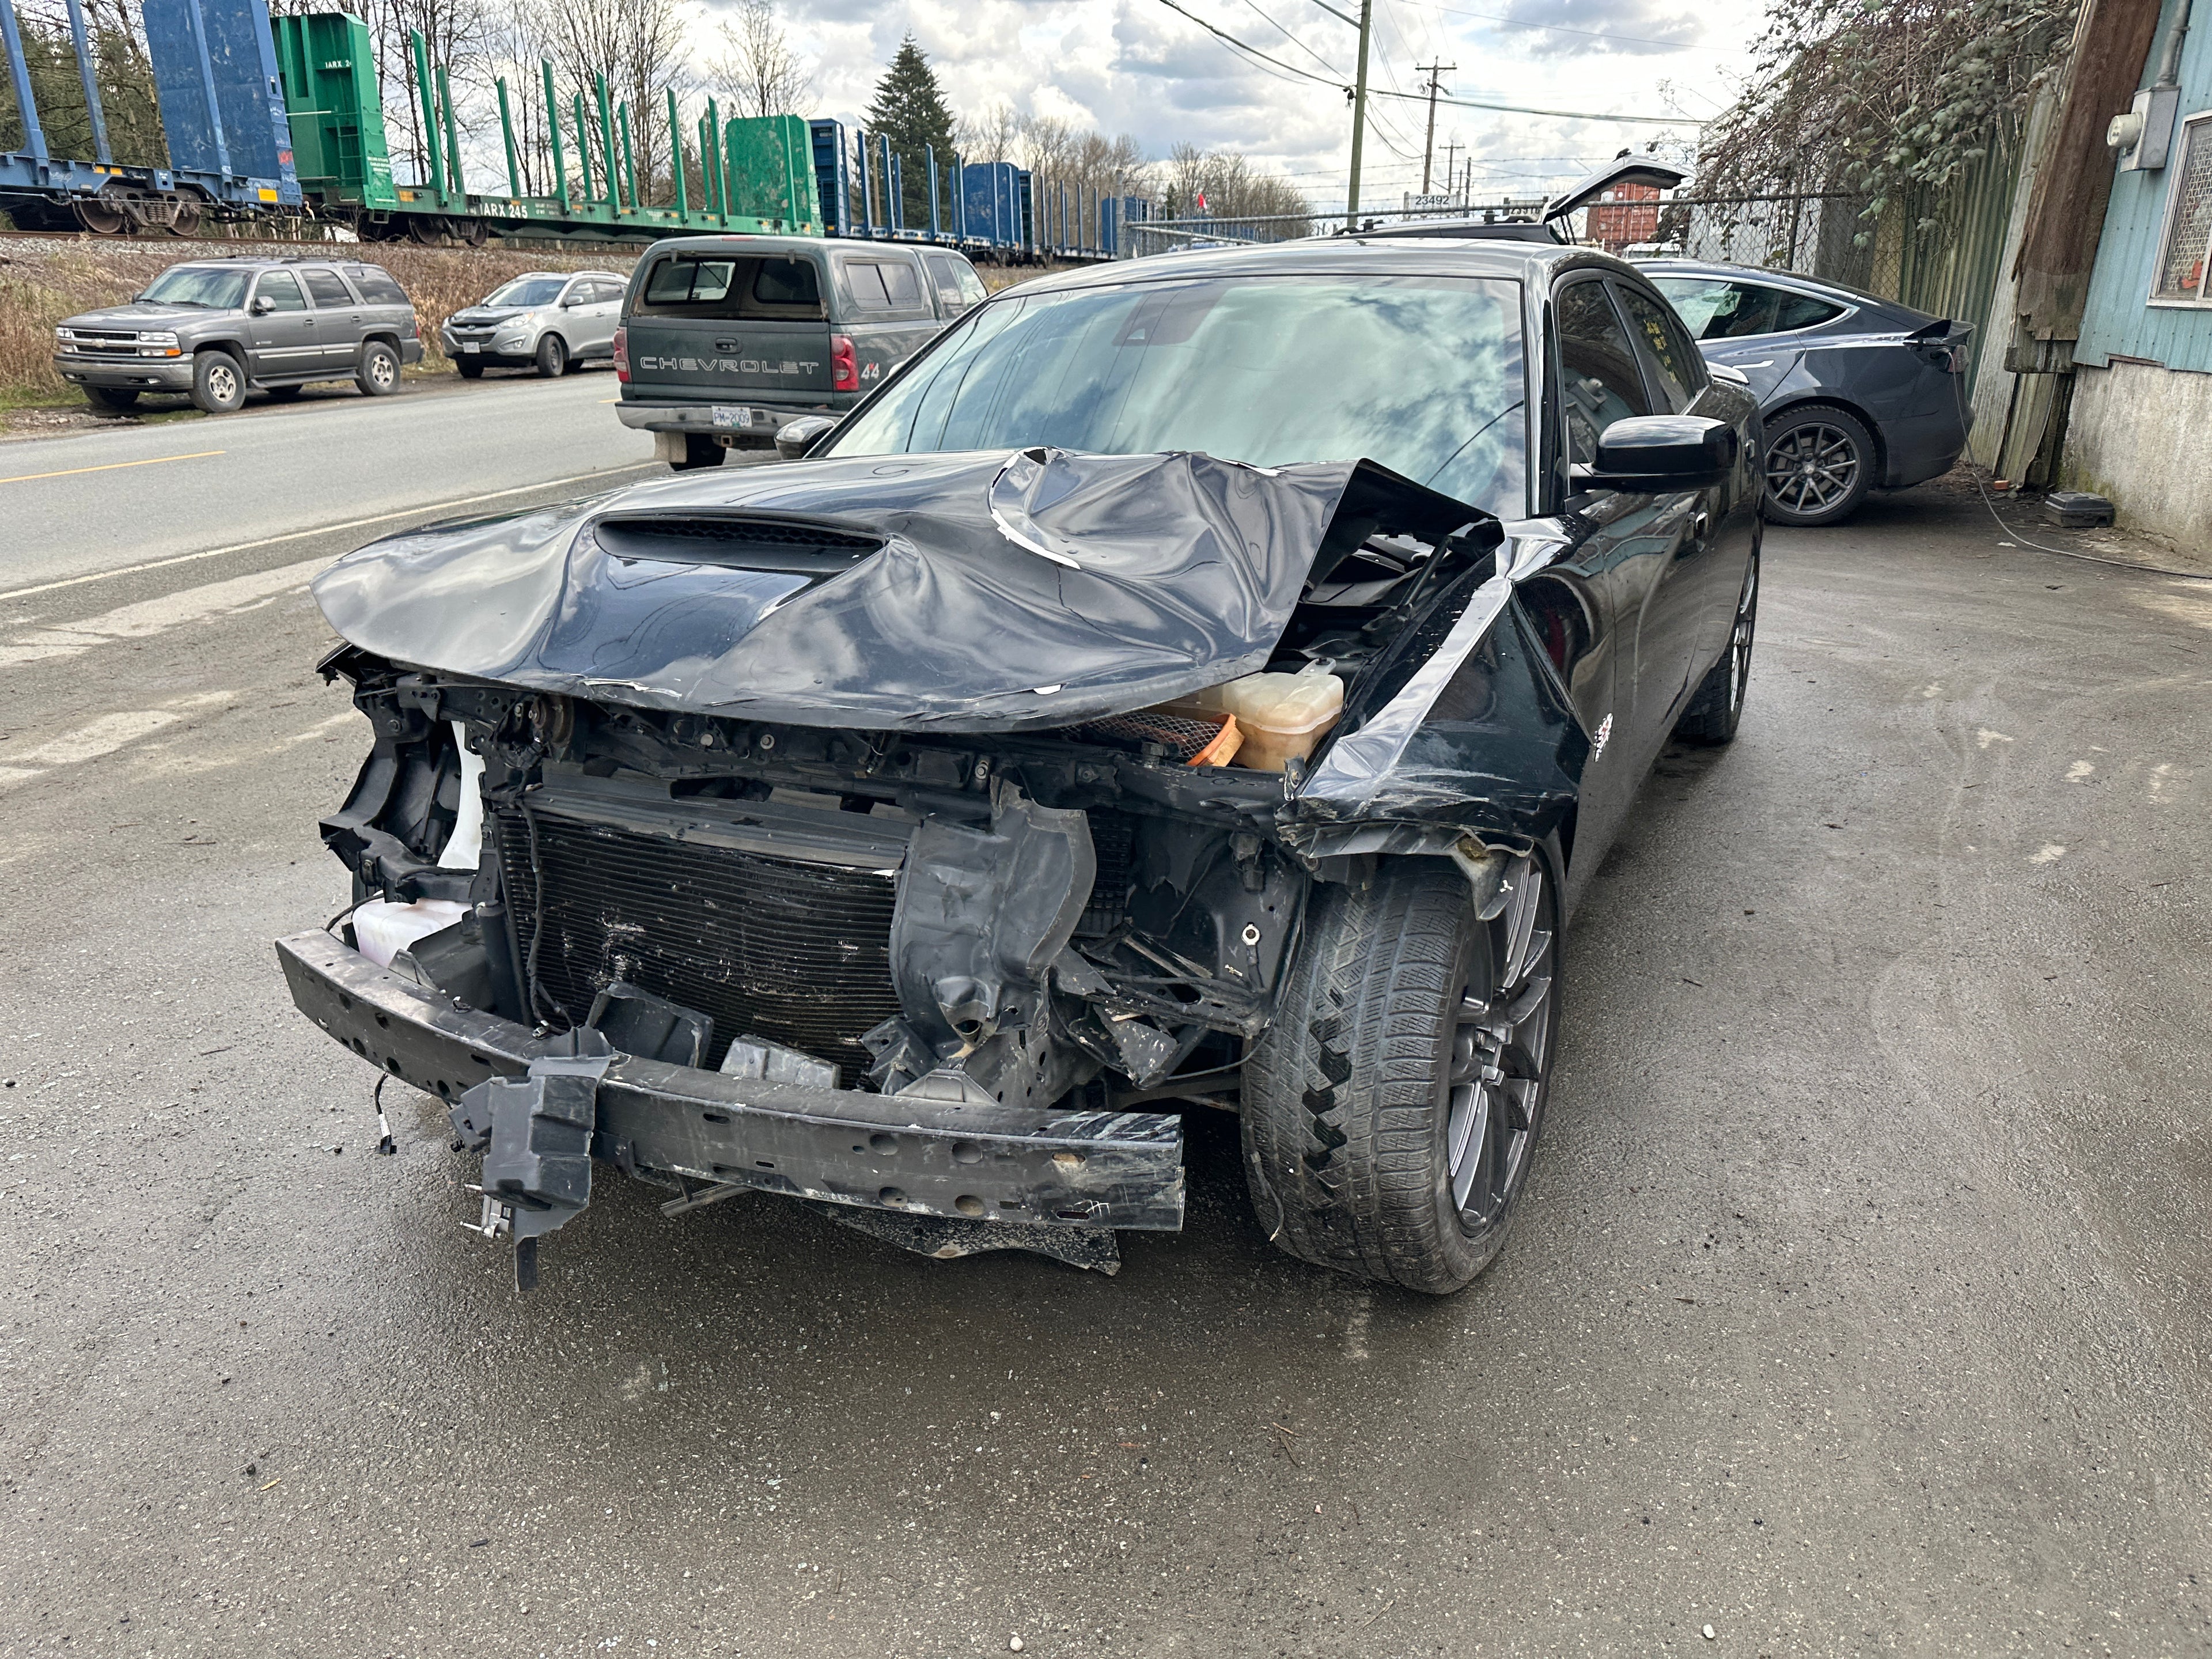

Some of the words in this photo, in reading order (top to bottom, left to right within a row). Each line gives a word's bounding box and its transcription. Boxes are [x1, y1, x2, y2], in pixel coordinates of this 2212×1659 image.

[325, 60, 342, 69] IARX
[1415, 196, 1449, 204] 23492
[480, 203, 506, 217] IARX
[509, 205, 528, 219] 245
[640, 357, 819, 374] CHEVROLET
